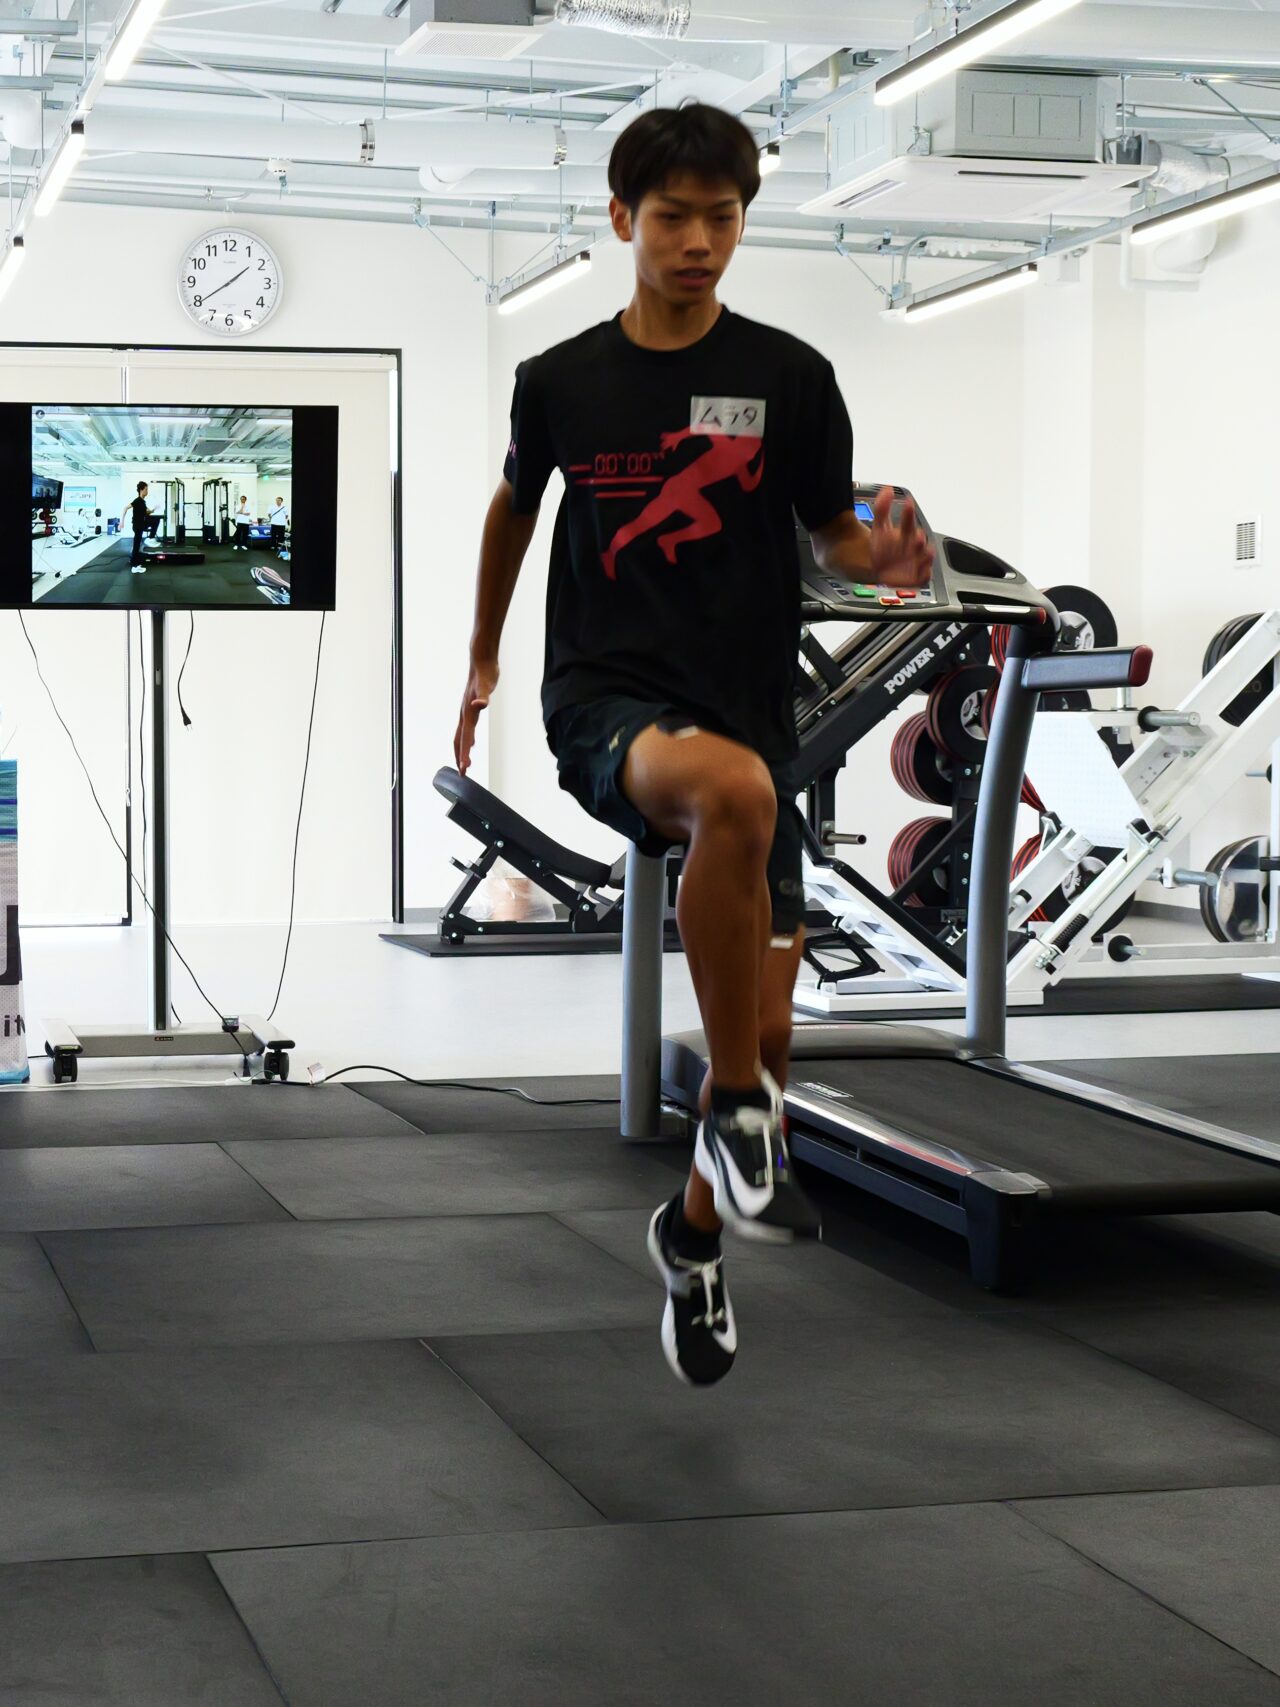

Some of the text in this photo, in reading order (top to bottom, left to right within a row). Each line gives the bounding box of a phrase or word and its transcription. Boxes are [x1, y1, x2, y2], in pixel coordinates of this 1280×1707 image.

[205, 245, 218, 257] 11
[223, 240, 237, 252] 12
[245, 246, 251, 258] 1
[192, 258, 207, 270] 10
[257, 259, 266, 271] 2
[187, 276, 196, 288] 9
[263, 278, 272, 290] 3
[193, 295, 203, 307] 8
[256, 296, 265, 308] 4
[209, 309, 217, 321] 7
[225, 314, 234, 327] 6
[243, 310, 252, 319] 5
[883, 647, 935, 695] POWER
